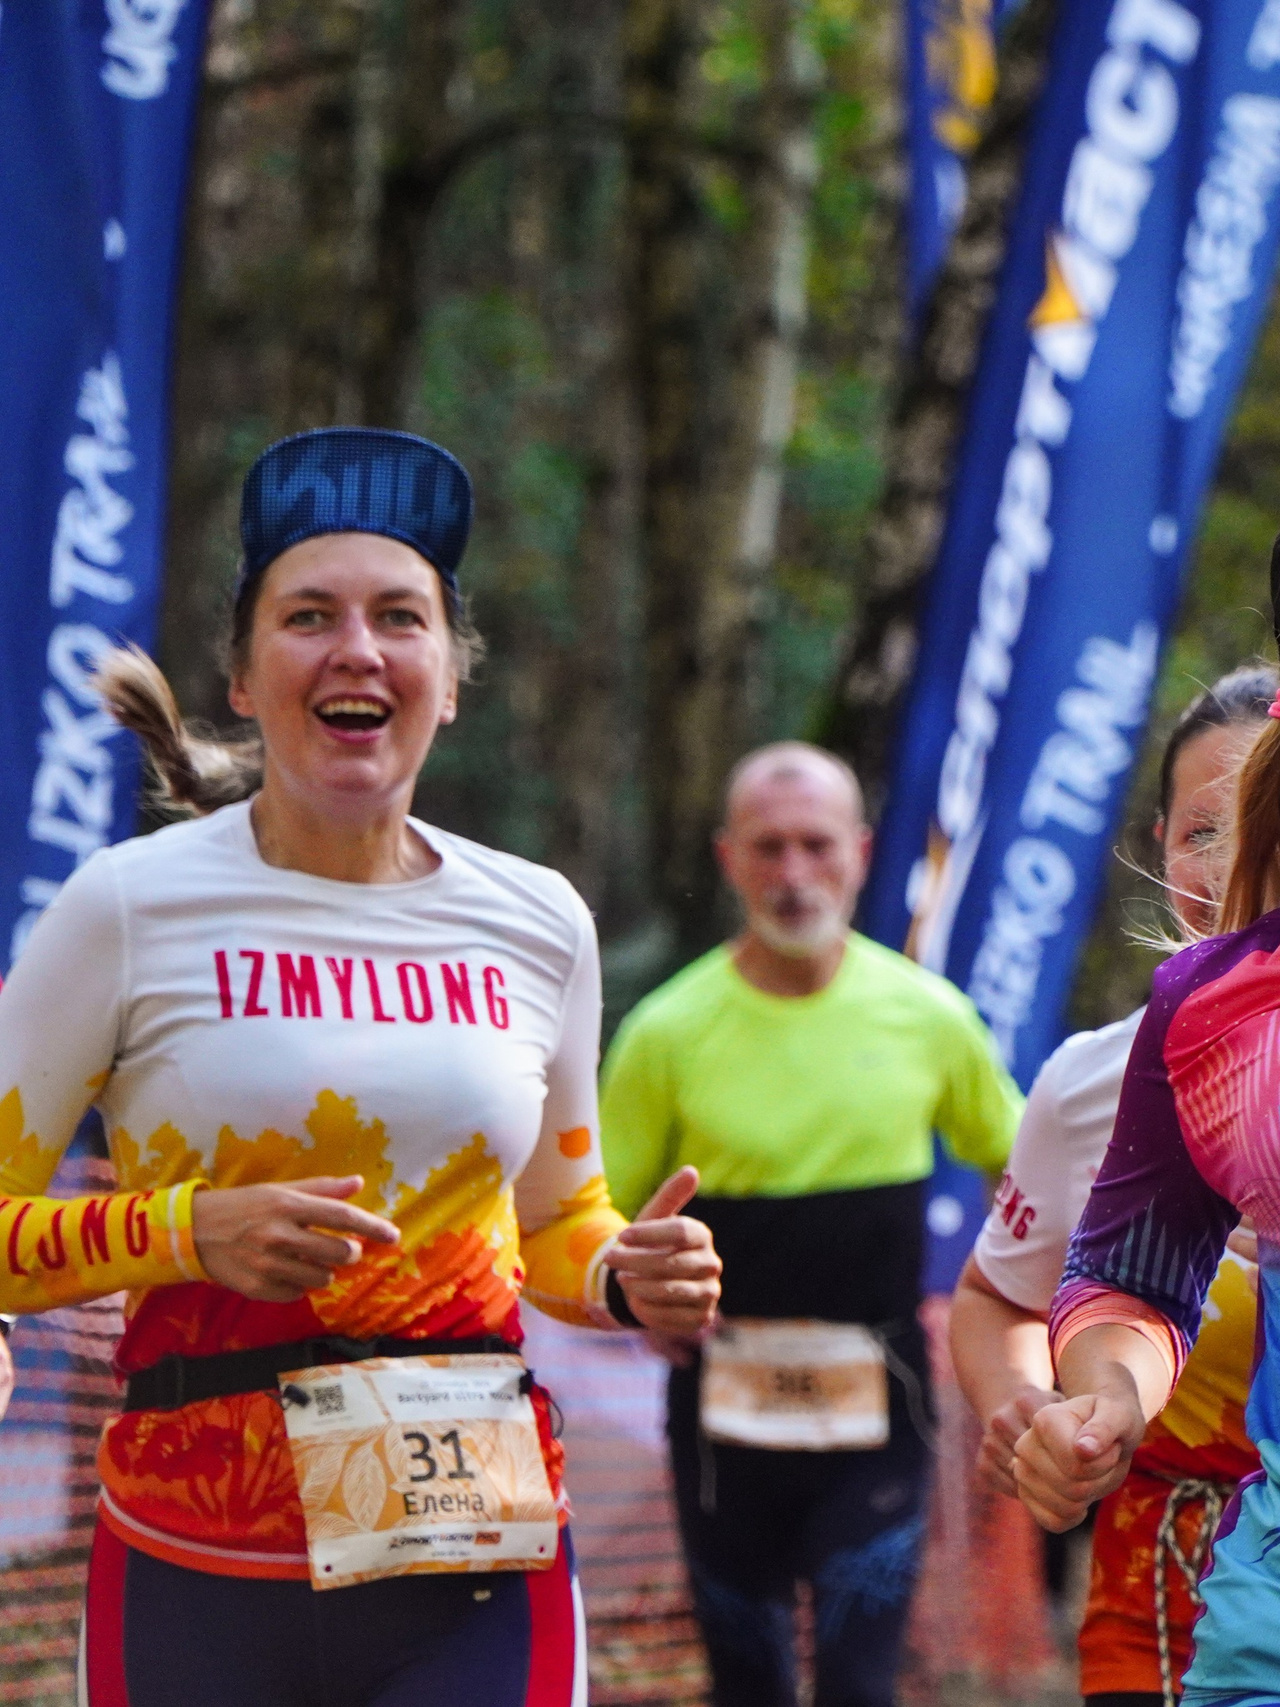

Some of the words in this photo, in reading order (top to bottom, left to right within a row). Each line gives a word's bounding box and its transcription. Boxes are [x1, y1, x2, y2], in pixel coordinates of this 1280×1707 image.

[213, 948, 509, 1030] IZMYLONG
[403, 1429, 476, 1483] 31
[403, 1490, 485, 1516] Елена
